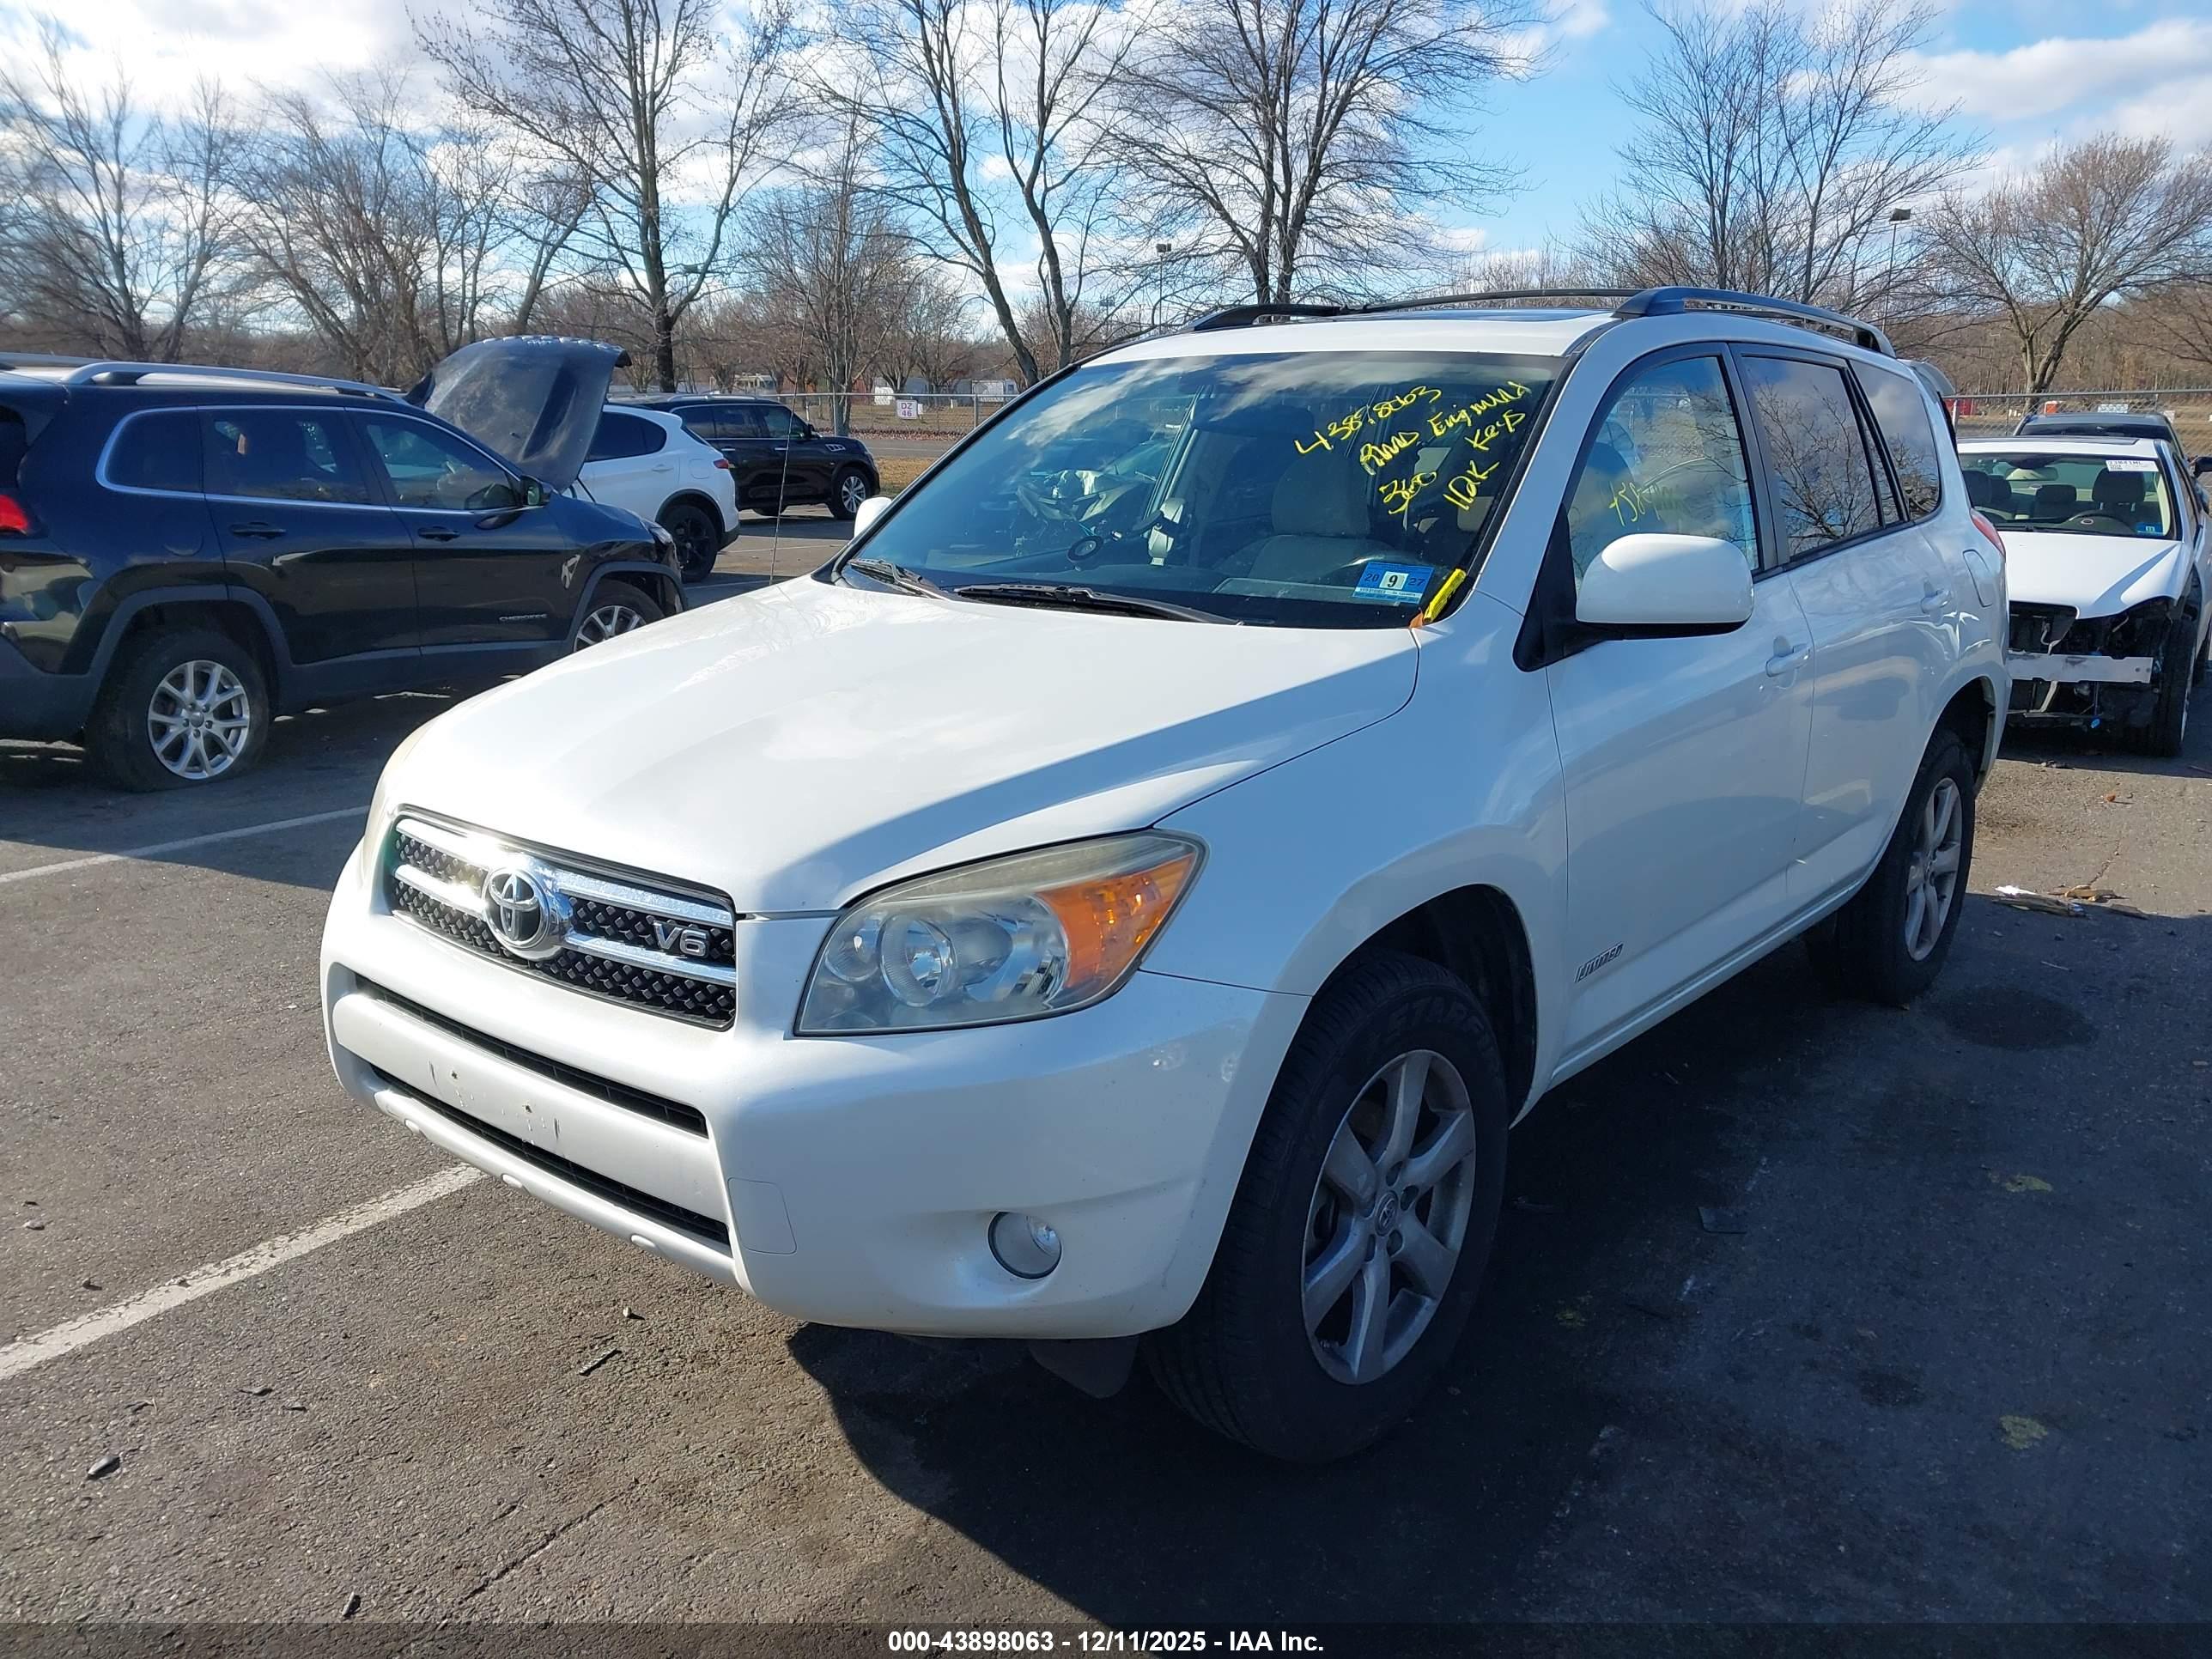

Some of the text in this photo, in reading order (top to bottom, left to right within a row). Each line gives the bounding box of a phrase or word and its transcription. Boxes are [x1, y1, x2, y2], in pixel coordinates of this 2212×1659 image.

[1364, 573, 1425, 588] 20 9 27
[653, 921, 709, 958] V6
